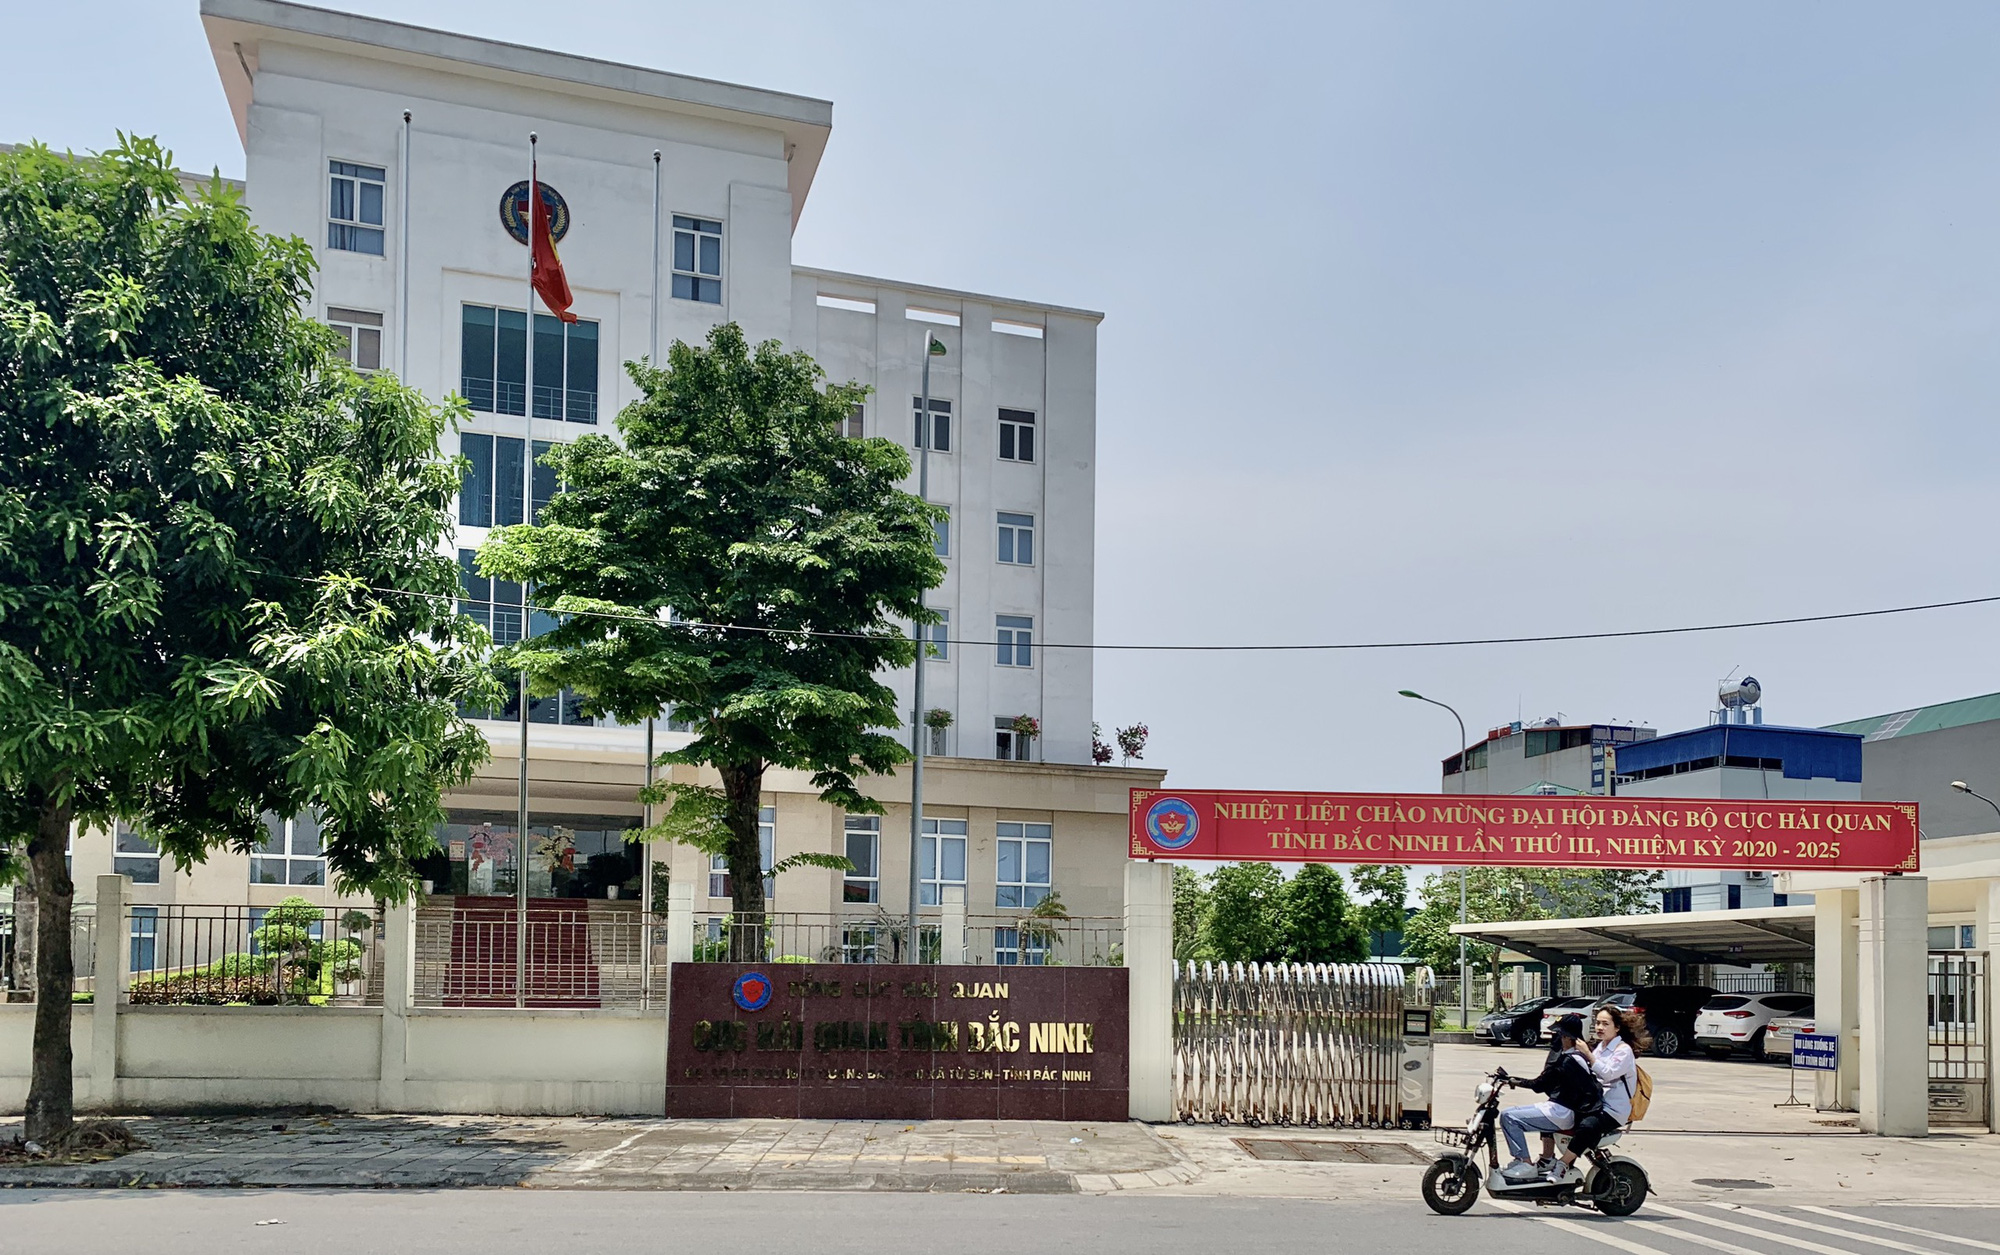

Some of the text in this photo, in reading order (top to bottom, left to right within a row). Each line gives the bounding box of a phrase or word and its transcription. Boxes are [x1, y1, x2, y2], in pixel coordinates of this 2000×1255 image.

[1214, 798, 1289, 825] NHIỆT
[1295, 800, 1350, 826] LIỆT
[1356, 801, 1426, 823] CHÀO
[1431, 802, 1506, 825] MỪNG
[1511, 807, 1555, 829] ĐẠI
[1560, 803, 1606, 830] HỘI
[1611, 804, 1680, 828] ĐẢNG
[1685, 806, 1718, 834] BỘ
[1723, 811, 1773, 834] CỤC
[1778, 807, 1821, 831] HẢI
[1826, 813, 1892, 834] QUAN
[1267, 826, 1327, 850] TỈNH
[1332, 825, 1382, 851] BẮC
[1388, 834, 1450, 852] NINH
[1455, 827, 1505, 853] LẦN
[1510, 831, 1563, 854] THỨ
[1567, 837, 1601, 858] III,
[1606, 833, 1687, 861] NHIỆM
[1692, 834, 1727, 857] KỲ
[1732, 840, 1778, 858] 2020
[1795, 841, 1841, 860] 2025
[951, 981, 1009, 999] QUAN
[967, 1009, 1020, 1053] BẮC
[1029, 1022, 1094, 1054] NINH
[1002, 1065, 1031, 1081] TỈNH
[1033, 1065, 1058, 1082] BẮC
[1061, 1070, 1092, 1082] NINH
